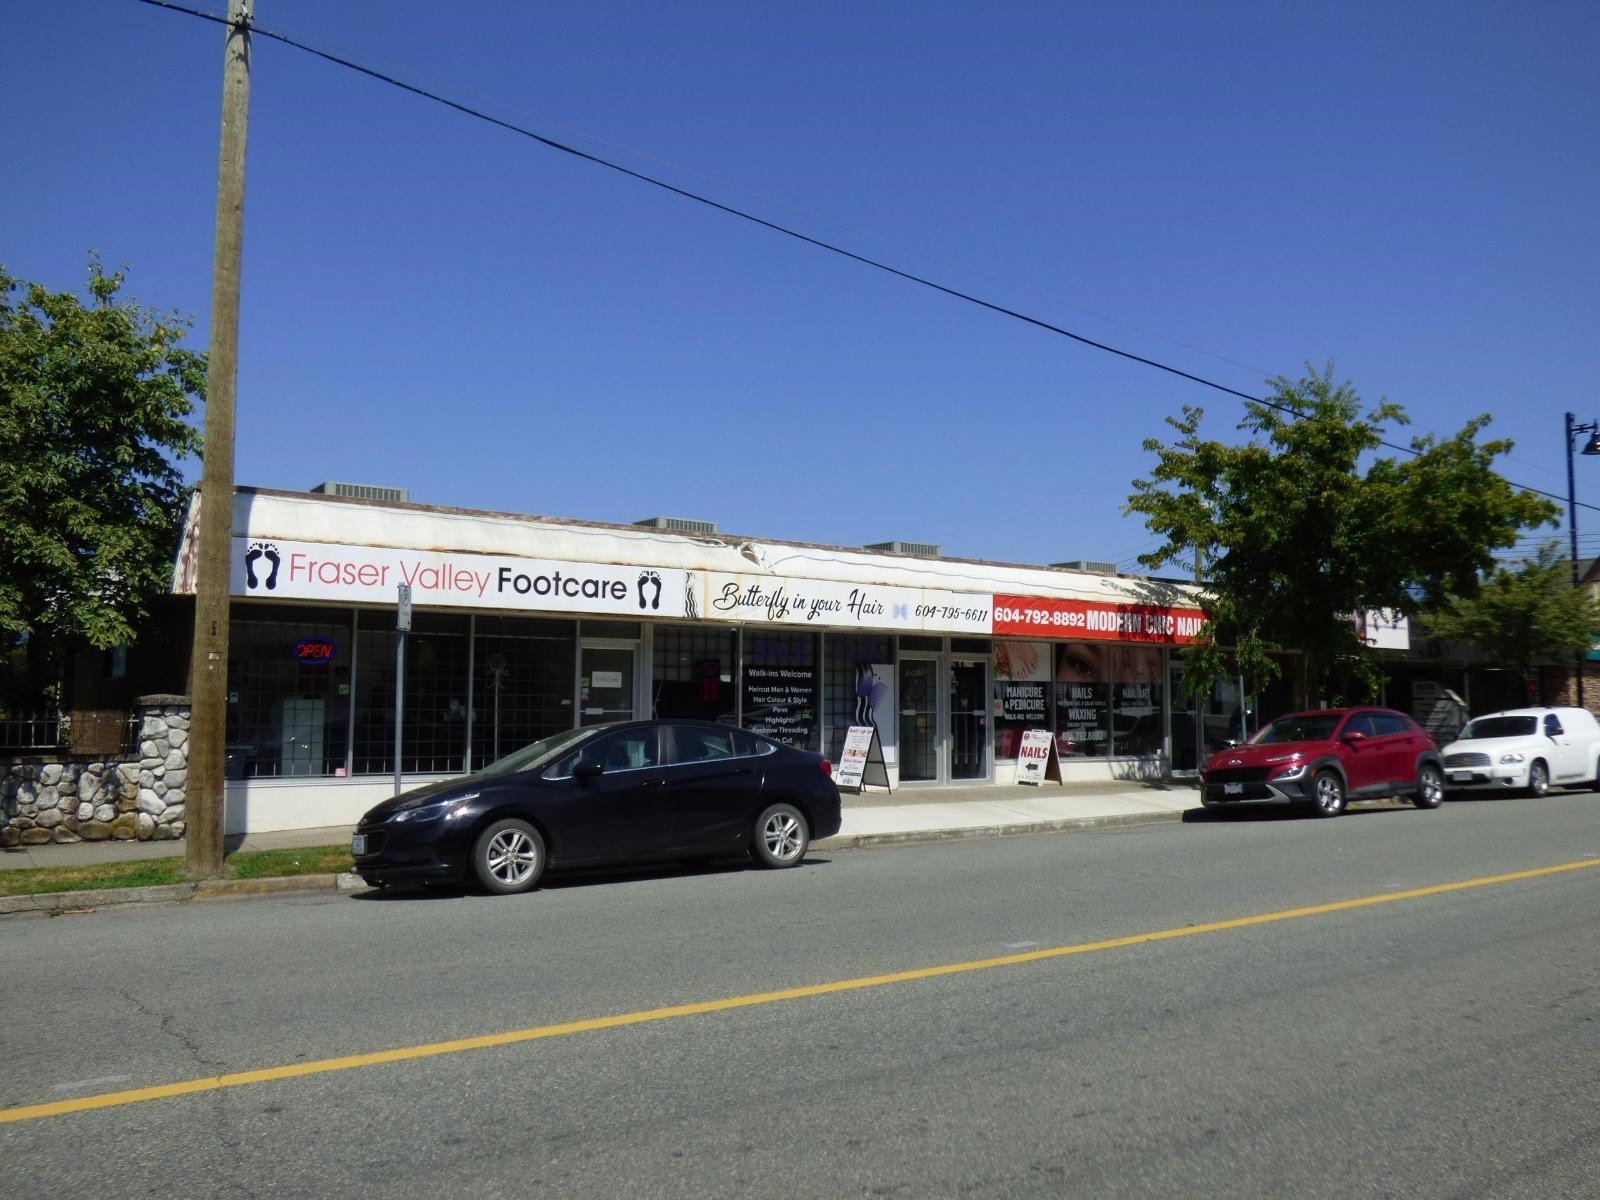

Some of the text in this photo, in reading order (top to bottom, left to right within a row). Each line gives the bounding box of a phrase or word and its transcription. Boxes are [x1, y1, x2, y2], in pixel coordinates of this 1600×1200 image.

[289, 553, 628, 601] Fraser Valley Footcare
[712, 582, 988, 622] Butterfly in your Hair 604-795-6611
[994, 607, 1210, 637] 604-792-8892 MODERN CHIC NAIL
[296, 643, 332, 658] OPEN
[748, 668, 812, 679] Walk-ins Welcome
[748, 685, 770, 693] Haircut
[790, 686, 812, 694] Women
[1006, 686, 1043, 698] MANICURE
[1071, 687, 1093, 699] NAILS
[792, 697, 808, 705] Style
[765, 716, 795, 725] Highlights
[1068, 708, 1097, 721] WAXING
[779, 726, 808, 735] Threading
[1020, 746, 1048, 759] NAILS
